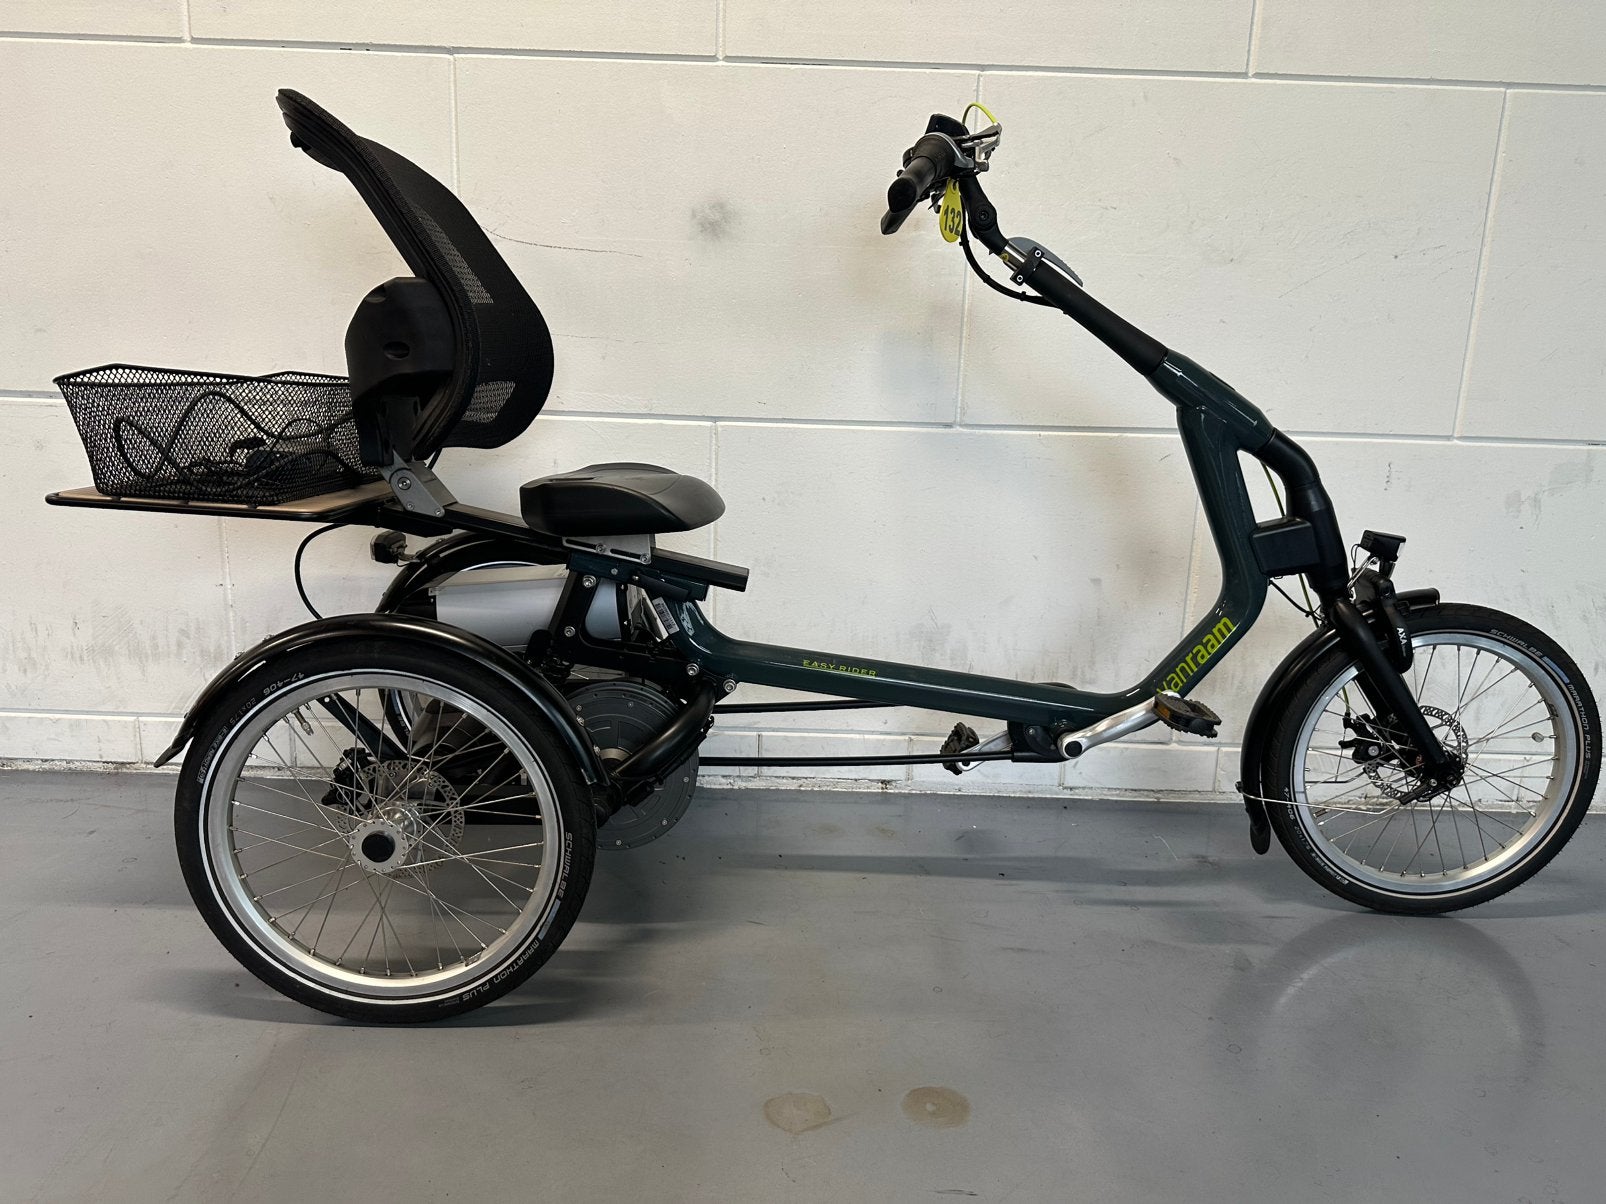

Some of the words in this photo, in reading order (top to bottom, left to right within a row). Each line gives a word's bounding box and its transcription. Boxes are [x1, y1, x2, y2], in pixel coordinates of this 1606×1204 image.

[944, 205, 962, 236] 132
[1397, 627, 1408, 645] AXA
[802, 659, 836, 670] EASY
[839, 665, 877, 677] RIDER
[263, 672, 305, 696] 47-406
[1489, 628, 1543, 657] SCHWALBE
[1567, 684, 1590, 731] MARATHON
[1584, 733, 1592, 759] PLUS
[557, 831, 573, 898] SCHWALBE
[493, 939, 540, 983] MARATHON
[462, 981, 490, 1001] PLUS
